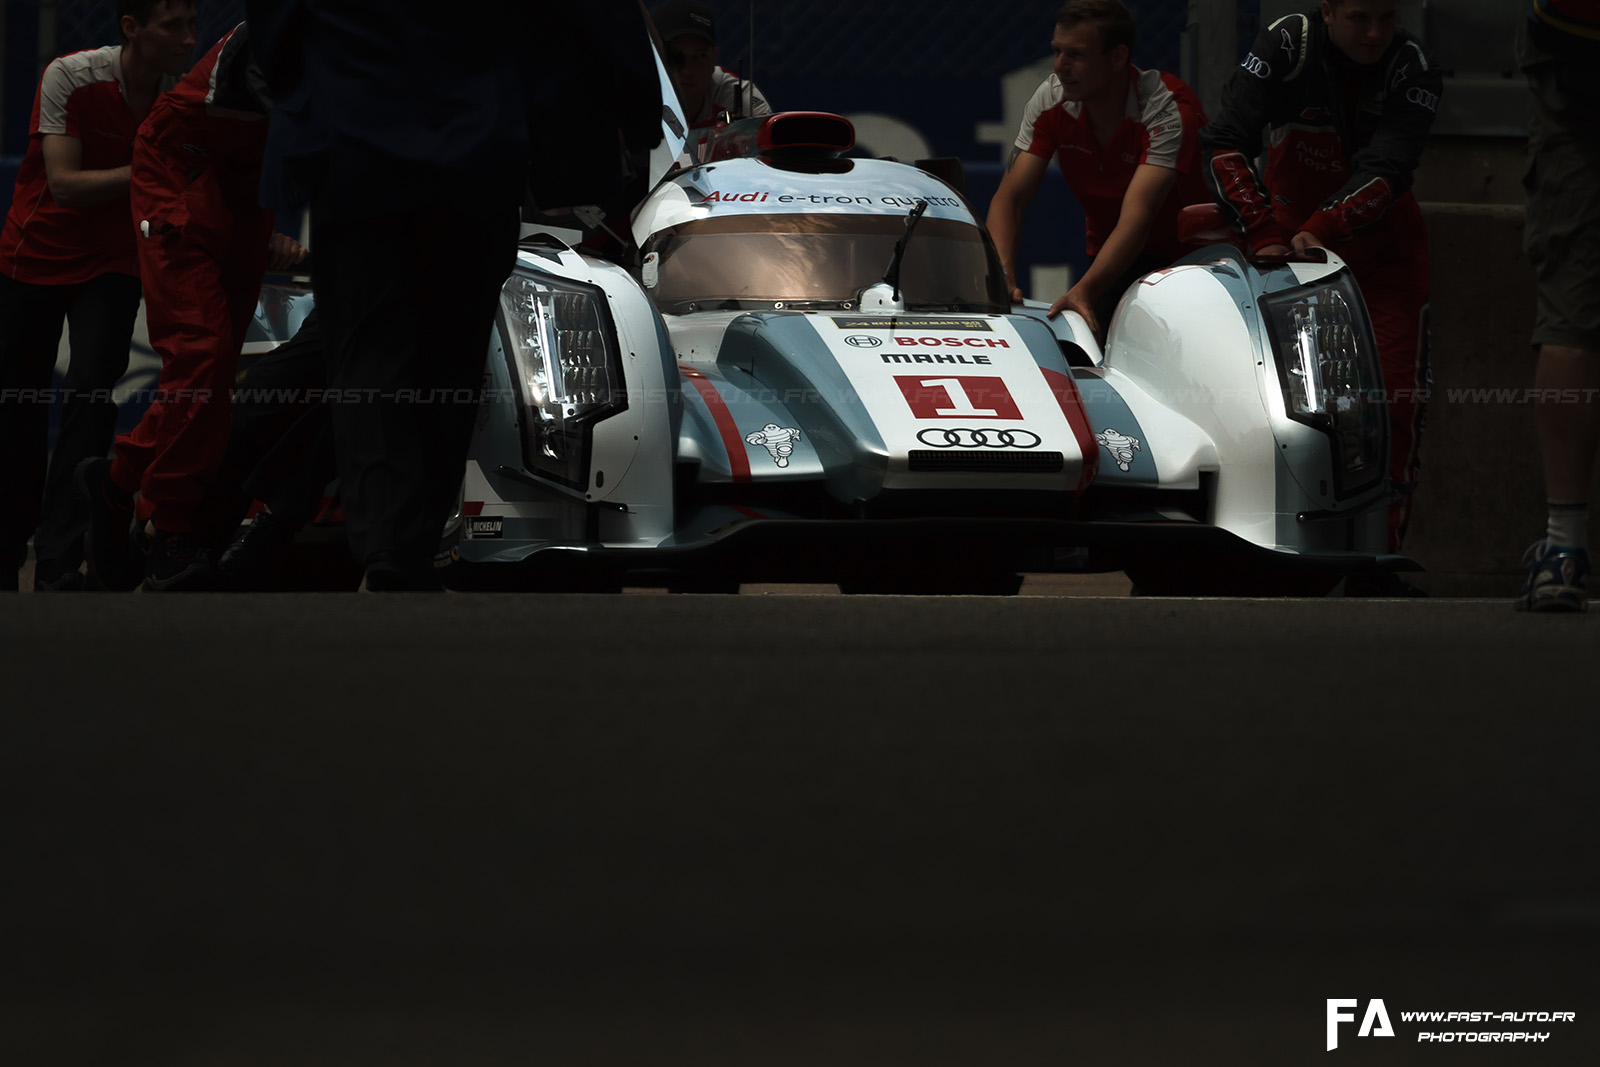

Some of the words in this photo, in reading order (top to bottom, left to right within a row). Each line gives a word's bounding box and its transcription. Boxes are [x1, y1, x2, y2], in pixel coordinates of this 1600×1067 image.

[1295, 140, 1335, 158] Audi
[1296, 151, 1327, 172] Top
[701, 191, 769, 202] Audi
[778, 194, 873, 204] e-tron
[894, 337, 1010, 348] BOSCH
[880, 354, 992, 364] MAHLE
[919, 378, 999, 416] 1
[473, 520, 503, 532] MICHELIN
